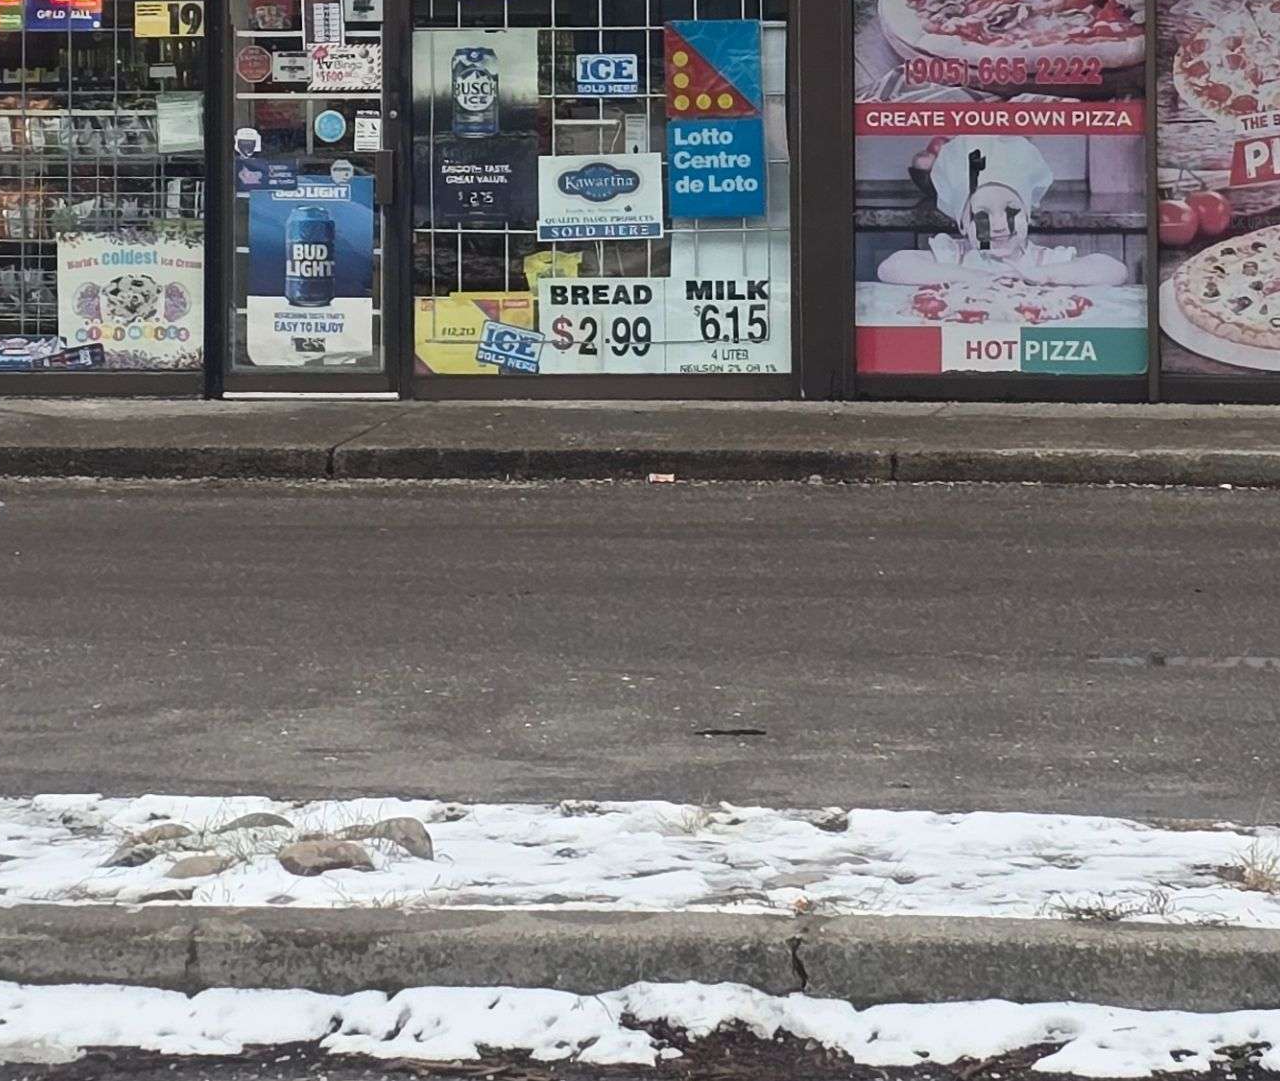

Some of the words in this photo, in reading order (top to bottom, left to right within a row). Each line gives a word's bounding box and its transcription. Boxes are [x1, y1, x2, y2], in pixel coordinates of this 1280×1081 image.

[167, 2, 203, 36] 19
[580, 57, 635, 81] ICE
[903, 57, 970, 86] (905)
[977, 55, 1028, 85] 665
[1034, 55, 1104, 85] 2222
[454, 82, 497, 96] BUSCH
[577, 84, 606, 93] SOLD
[608, 83, 638, 93] HERE
[463, 96, 488, 105] ICE
[866, 110, 946, 127] CREATE
[950, 110, 1010, 127] YOUR
[1014, 110, 1066, 127] OWN
[1071, 110, 1133, 127] PIZZA
[1240, 114, 1269, 131] THE
[673, 127, 734, 146] Lotto
[673, 150, 752, 170] Centre
[564, 174, 635, 191] Kawartha
[674, 175, 704, 194] de
[707, 174, 759, 193] Loto
[305, 186, 348, 198] LIGHT
[551, 226, 596, 238] SOLD
[604, 225, 651, 237] HERE
[101, 249, 158, 266] coldest
[292, 243, 329, 260] BUD
[285, 260, 335, 277] LIGHT
[550, 284, 653, 305] BREAD
[685, 280, 769, 301] MILK
[273, 321, 298, 332] EASY
[300, 321, 313, 332] TO
[314, 321, 345, 333] ENJOY
[693, 303, 768, 345] $6.15
[483, 326, 537, 358] ICE
[965, 340, 1019, 360] HOT
[1024, 340, 1098, 361] PIZZA
[477, 349, 506, 364] SOLD
[711, 349, 719, 361] 4
[721, 348, 749, 361] LITER
[679, 365, 725, 374] NEILSON
[745, 364, 761, 373] OR
